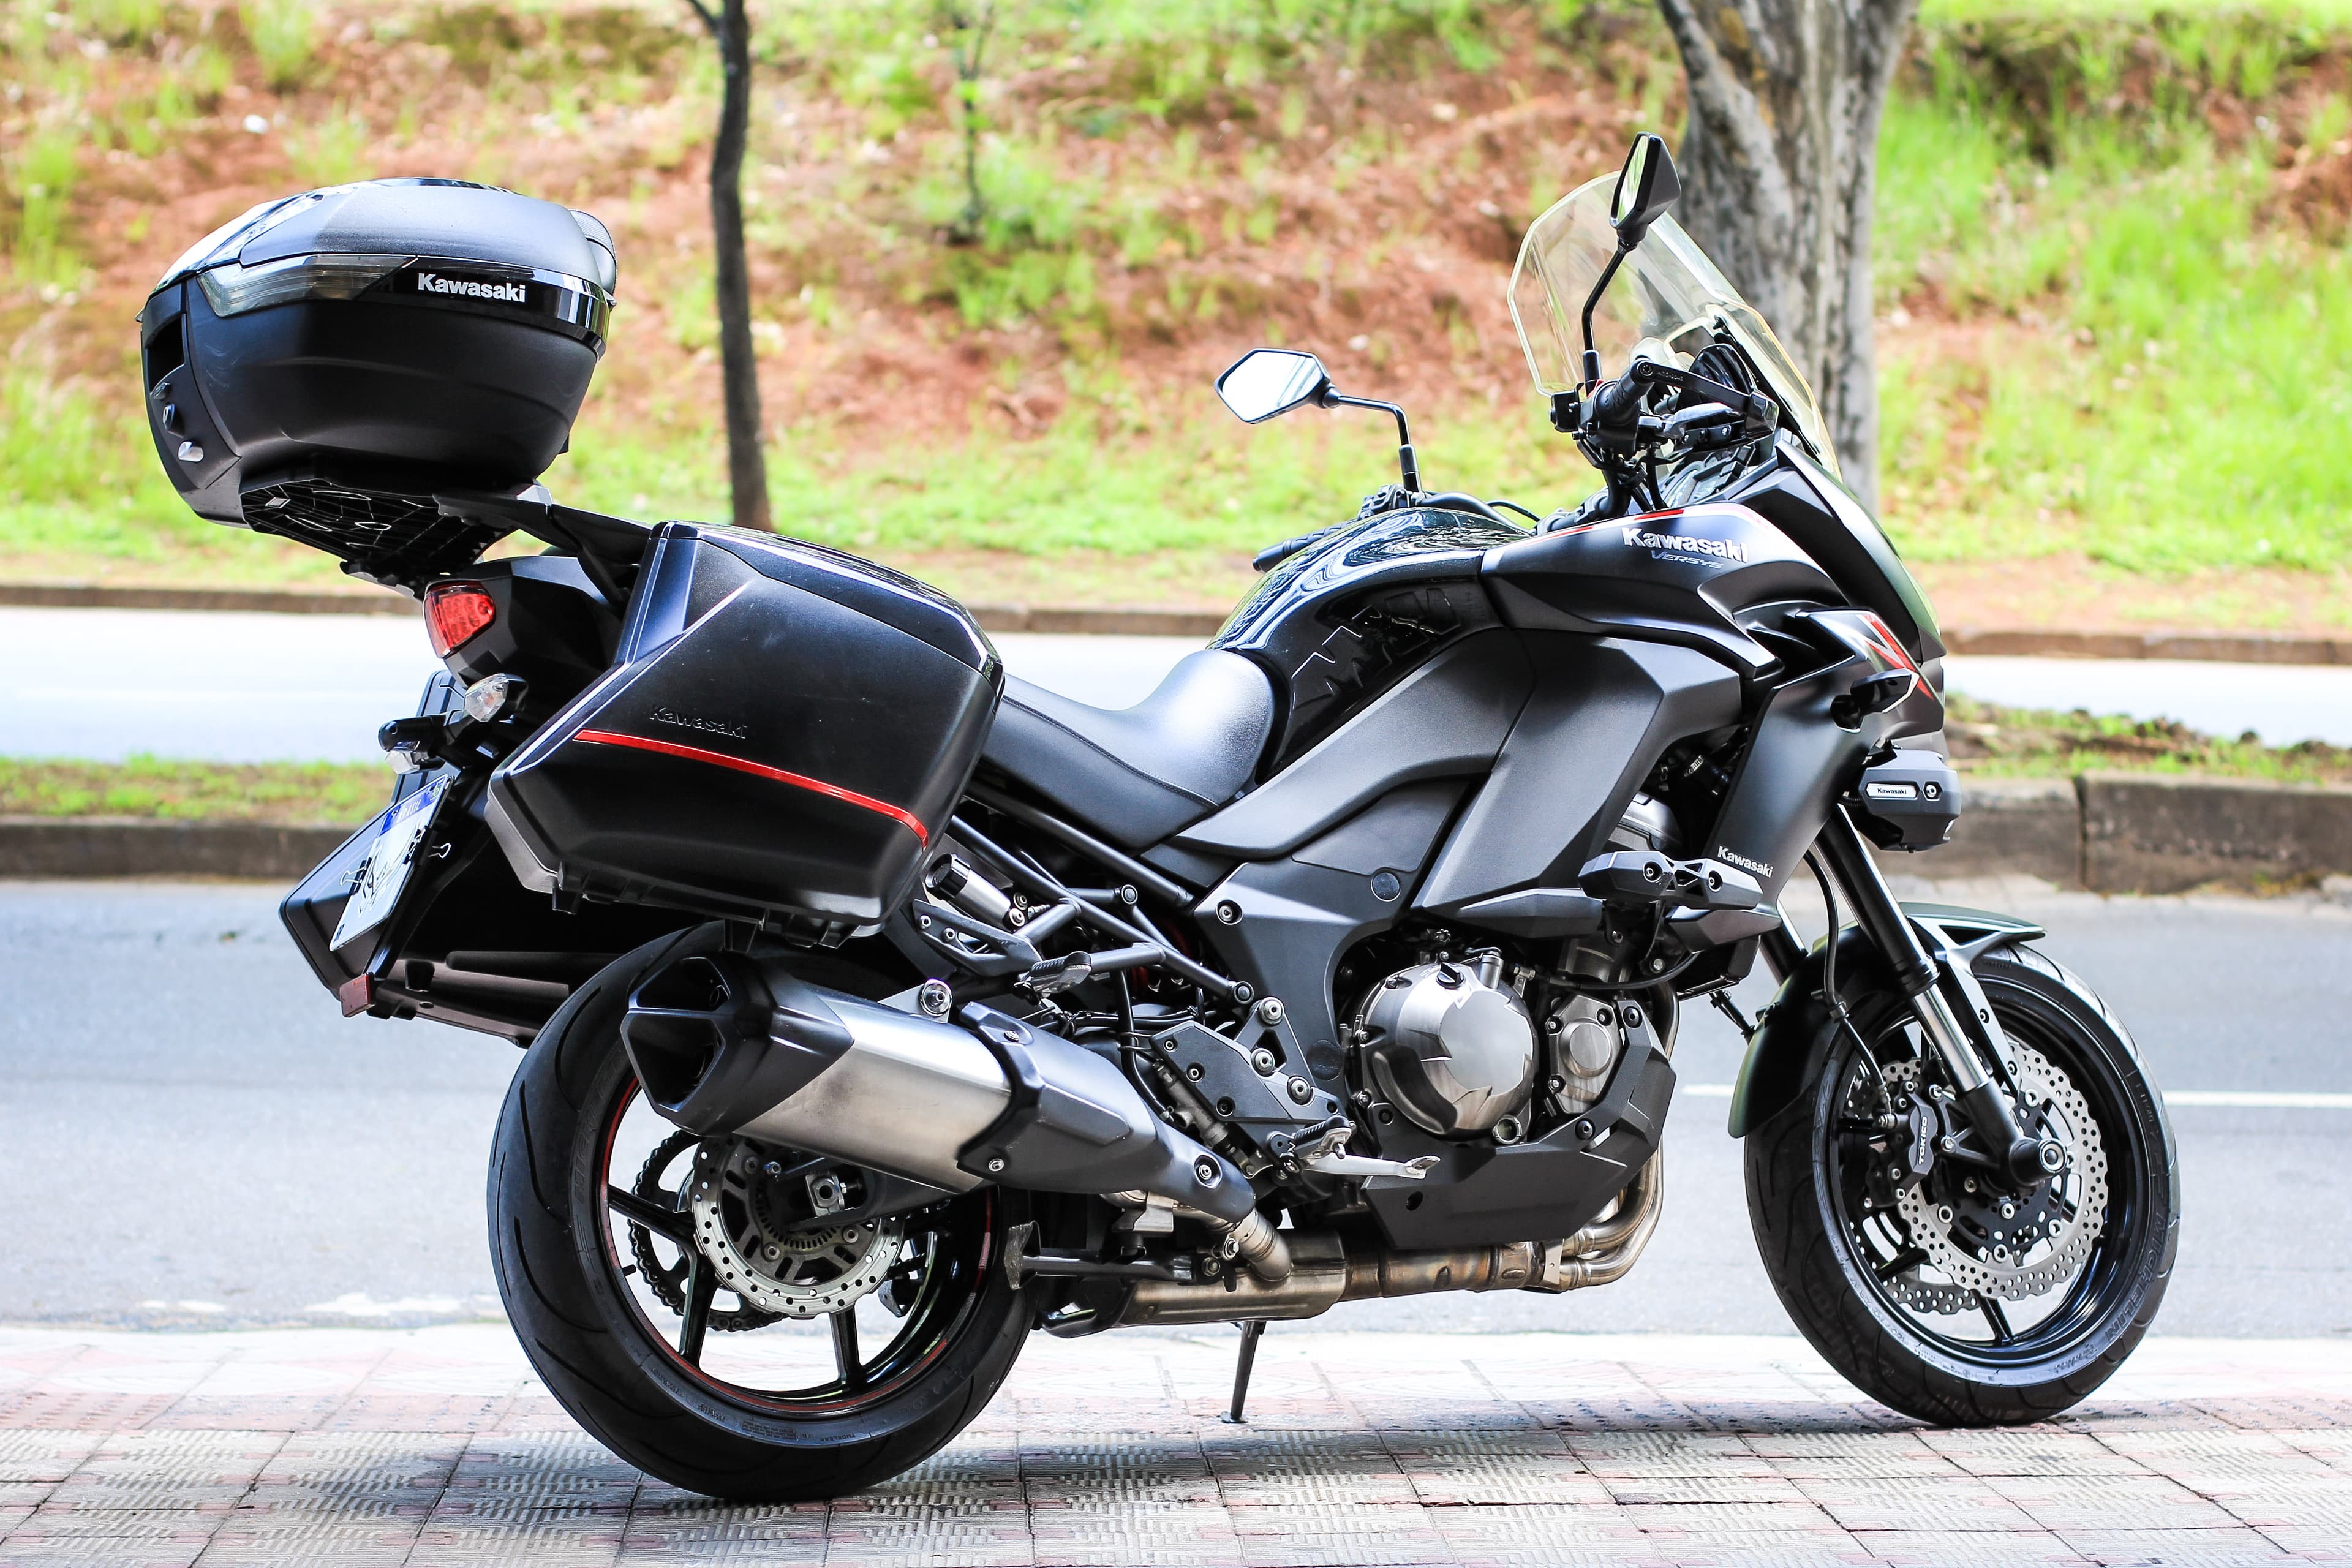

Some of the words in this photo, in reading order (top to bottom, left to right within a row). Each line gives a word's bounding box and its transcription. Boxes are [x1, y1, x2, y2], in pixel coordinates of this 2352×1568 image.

[418, 273, 526, 303] Kawasaki
[1621, 527, 1748, 563] Kawasaki
[1651, 550, 1724, 570] VERSYS
[649, 706, 748, 739] Kawasaki
[1717, 846, 1774, 878] Kawasaki
[1918, 1116, 1928, 1164] TOKICO
[2105, 1211, 2167, 1341] MICHELIN
